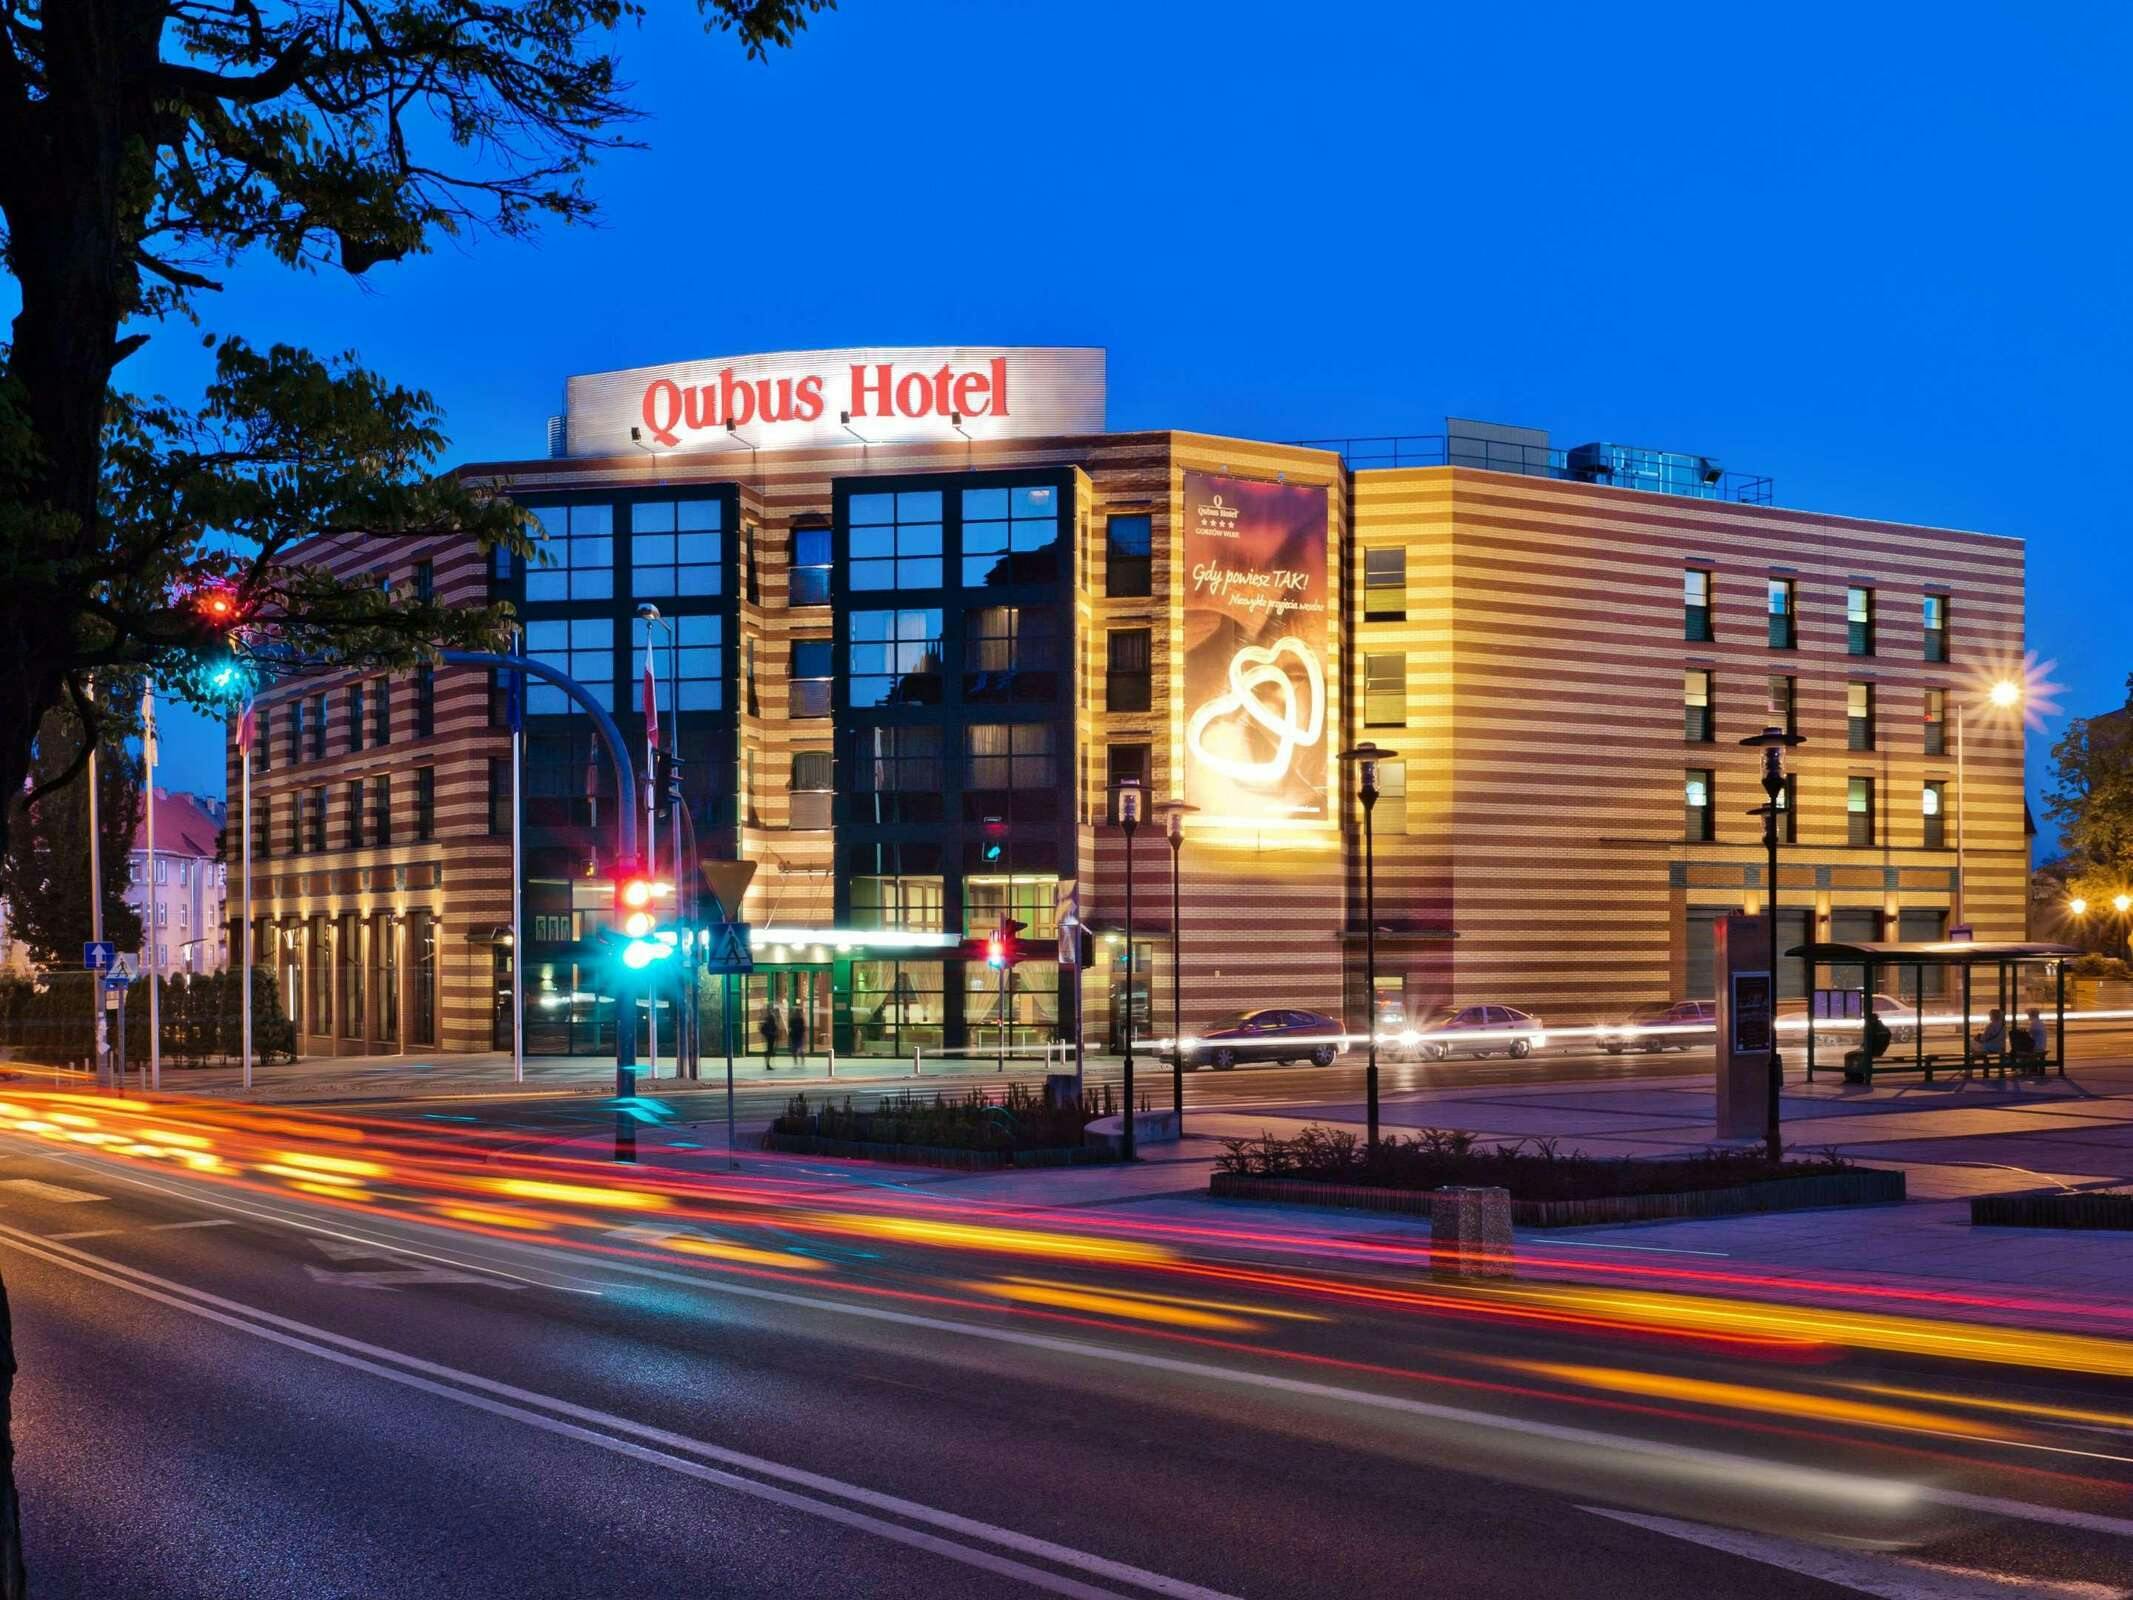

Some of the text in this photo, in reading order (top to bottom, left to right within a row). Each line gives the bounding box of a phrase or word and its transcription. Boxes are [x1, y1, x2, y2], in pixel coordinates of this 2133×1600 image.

[643, 356, 1009, 447] Qubus Hotel
[1192, 560, 1310, 596] Gdy powiesz TAK!
